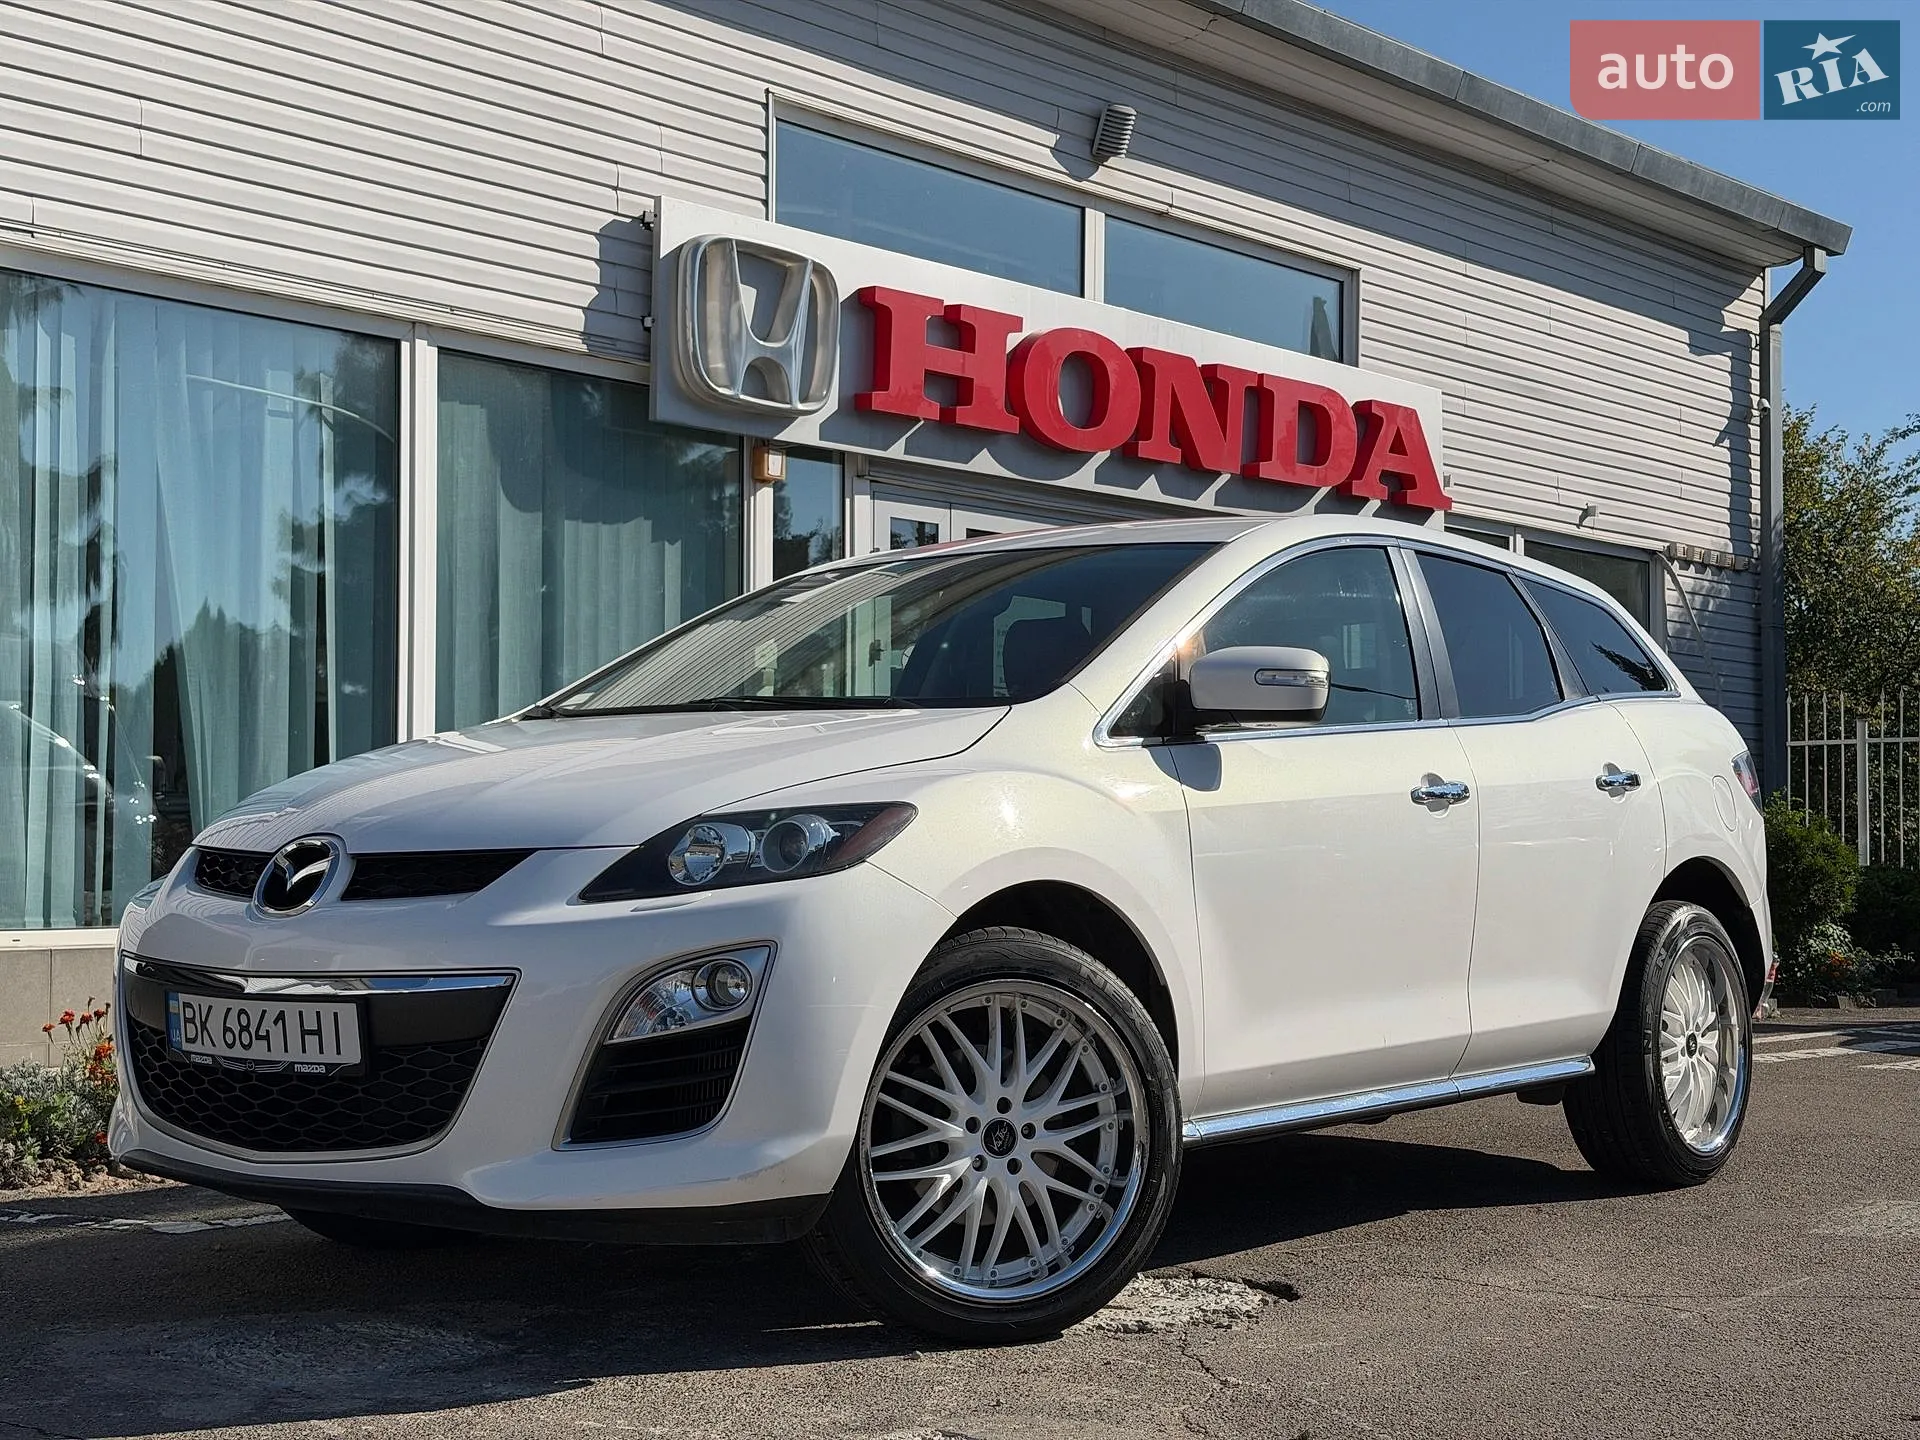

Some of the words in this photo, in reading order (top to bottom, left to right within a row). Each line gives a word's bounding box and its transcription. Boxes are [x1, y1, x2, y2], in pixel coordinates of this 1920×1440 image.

[854, 284, 1453, 511] HONDA
[171, 1029, 182, 1042] UA
[182, 1001, 217, 1048] BK
[222, 1006, 289, 1053] 6841
[298, 1010, 342, 1056] HI
[294, 1063, 326, 1074] mazda
